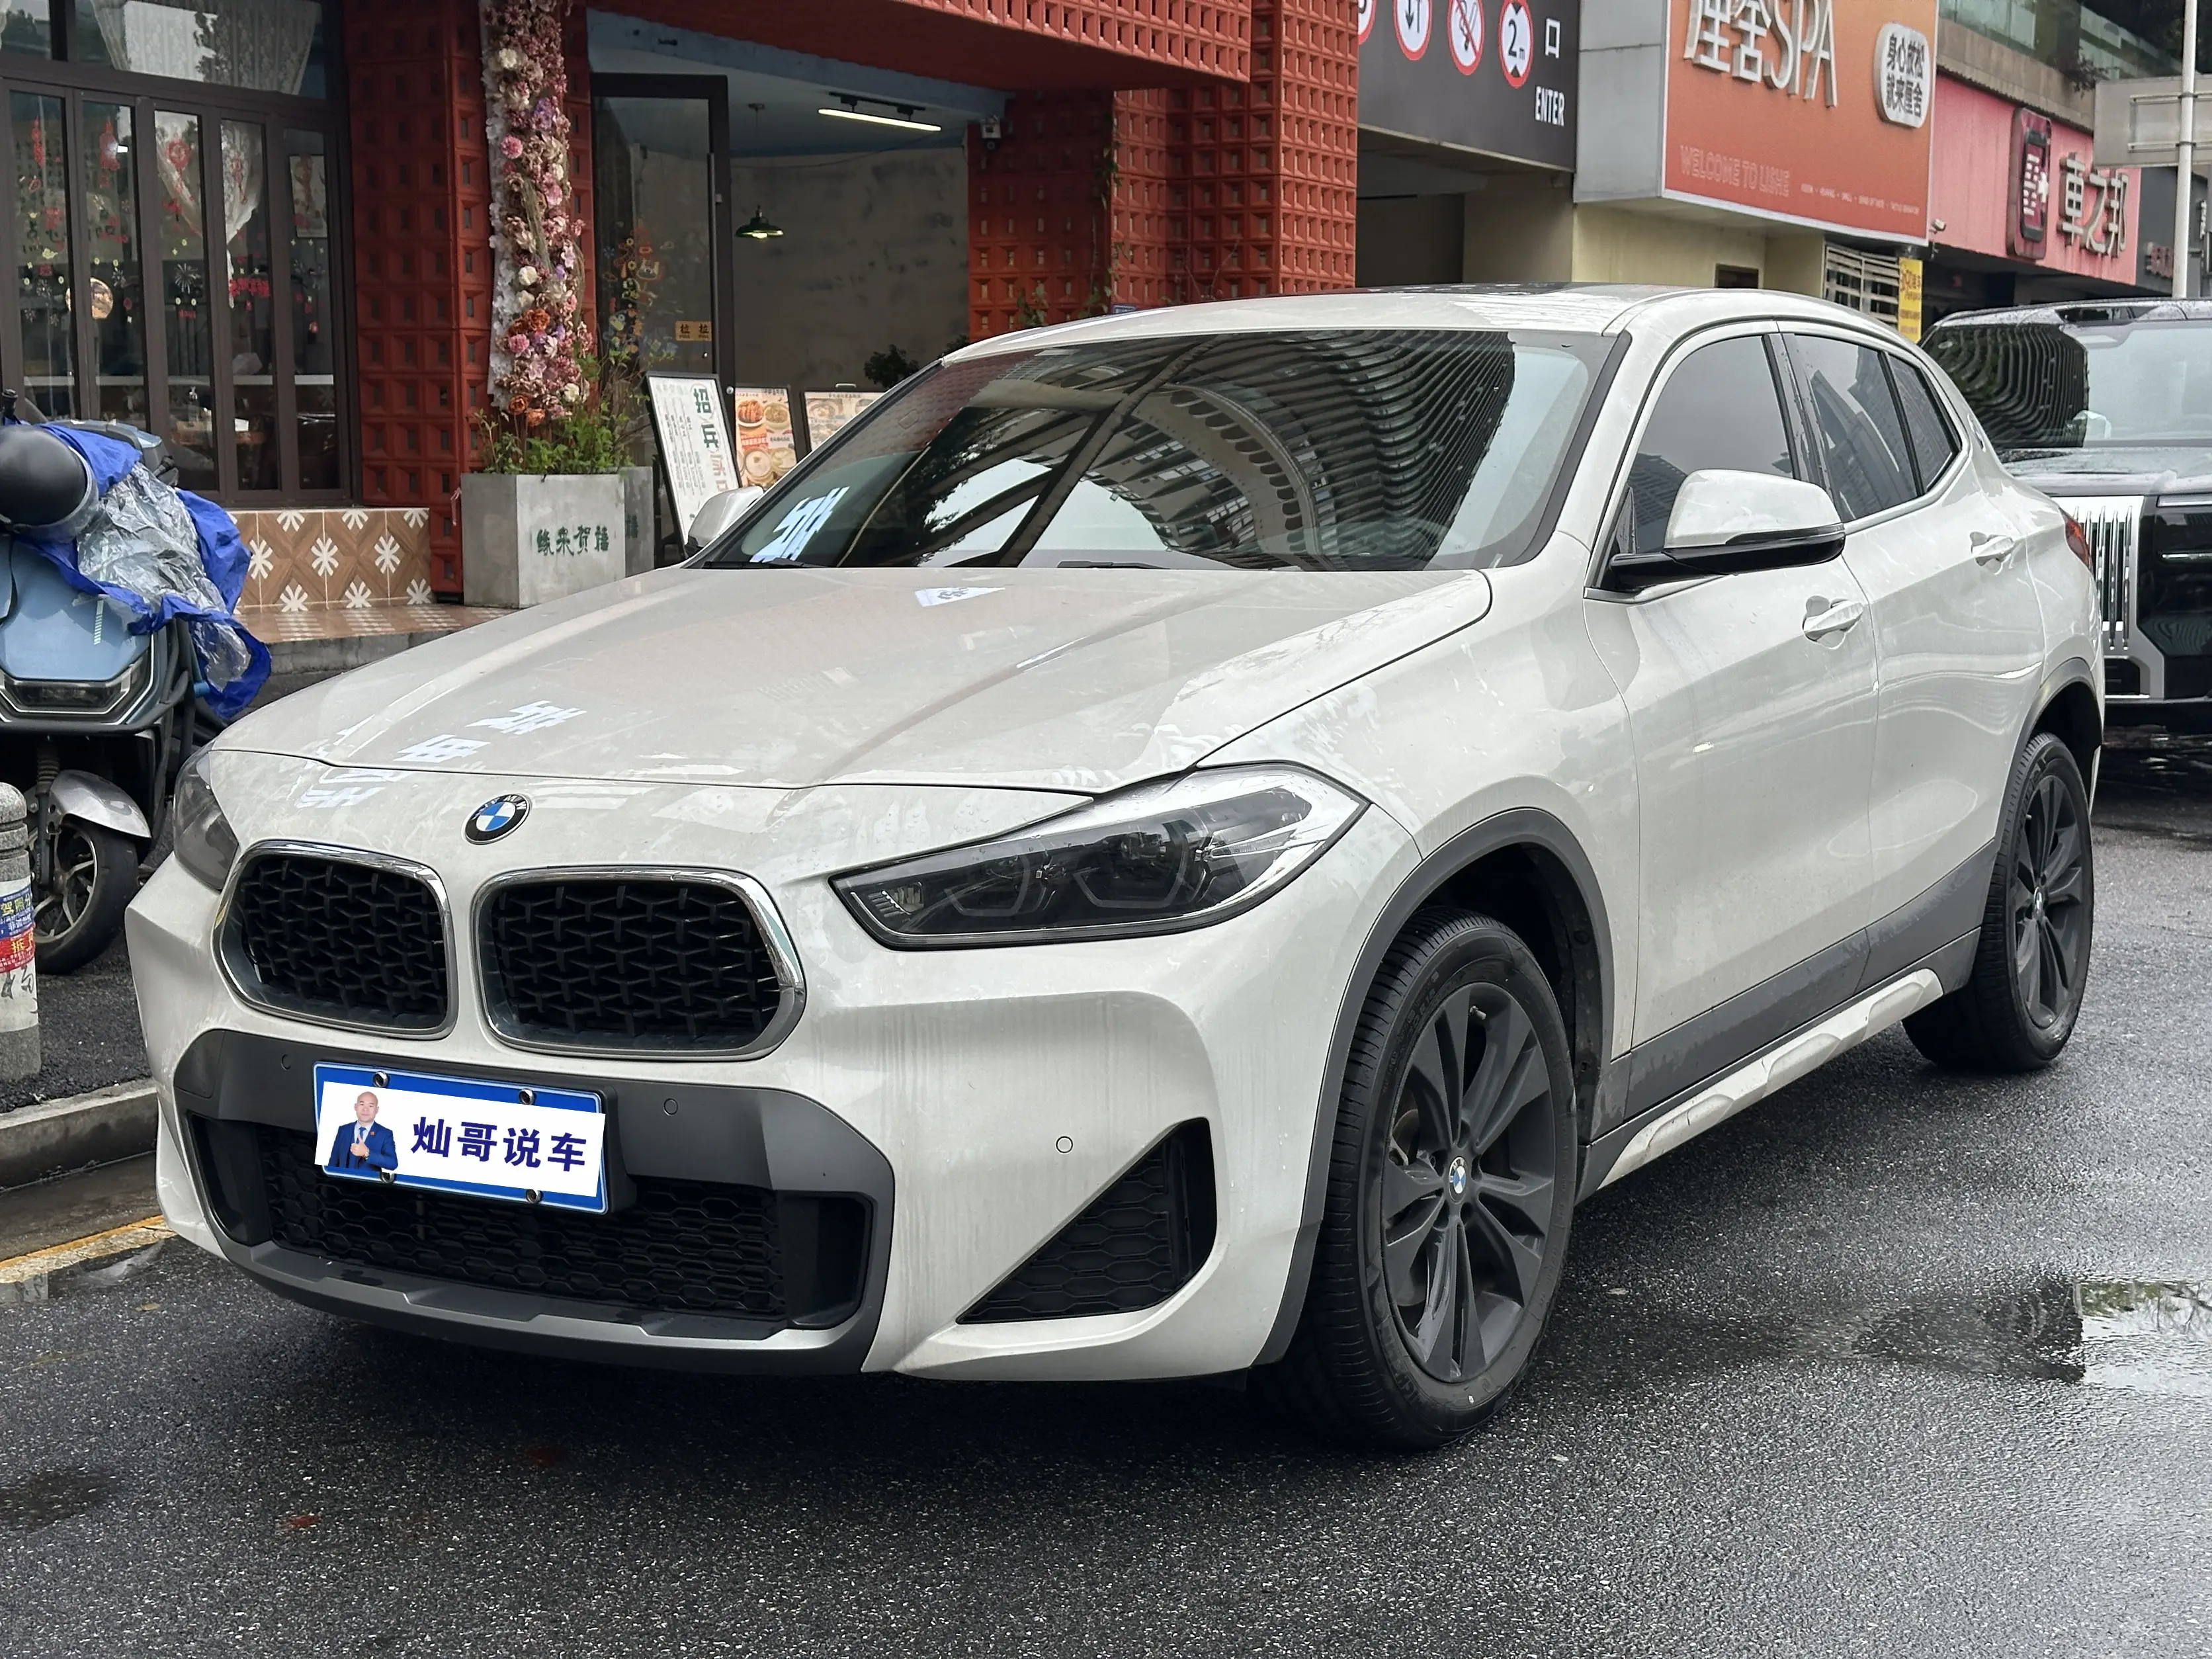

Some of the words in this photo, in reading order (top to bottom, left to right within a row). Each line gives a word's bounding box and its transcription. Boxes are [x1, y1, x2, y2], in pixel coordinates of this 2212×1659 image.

[1535, 85, 1564, 126] ENTER
[1680, 144, 1740, 187] WELCOME
[1742, 160, 1757, 190] TO
